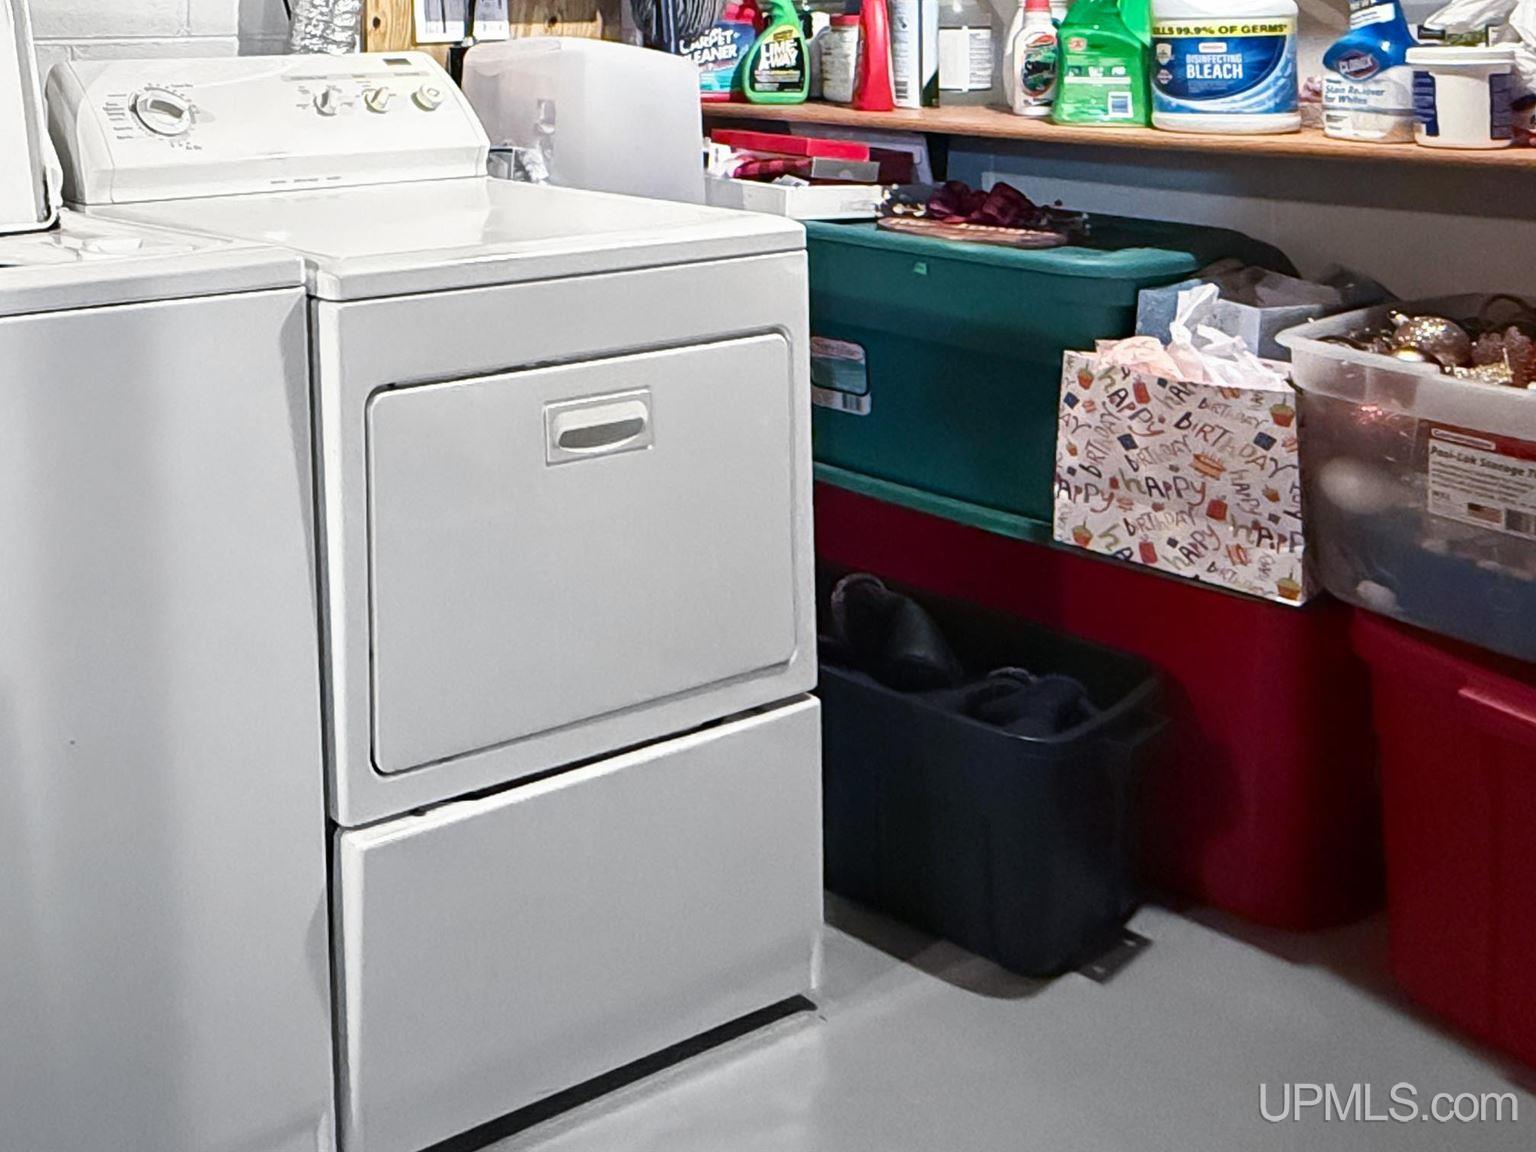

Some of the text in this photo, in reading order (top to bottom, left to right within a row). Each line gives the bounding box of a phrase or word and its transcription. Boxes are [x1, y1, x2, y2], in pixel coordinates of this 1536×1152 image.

[1175, 26, 1214, 36] 99.9%
[1217, 25, 1238, 35] OF
[1186, 63, 1243, 79] BLEACH
